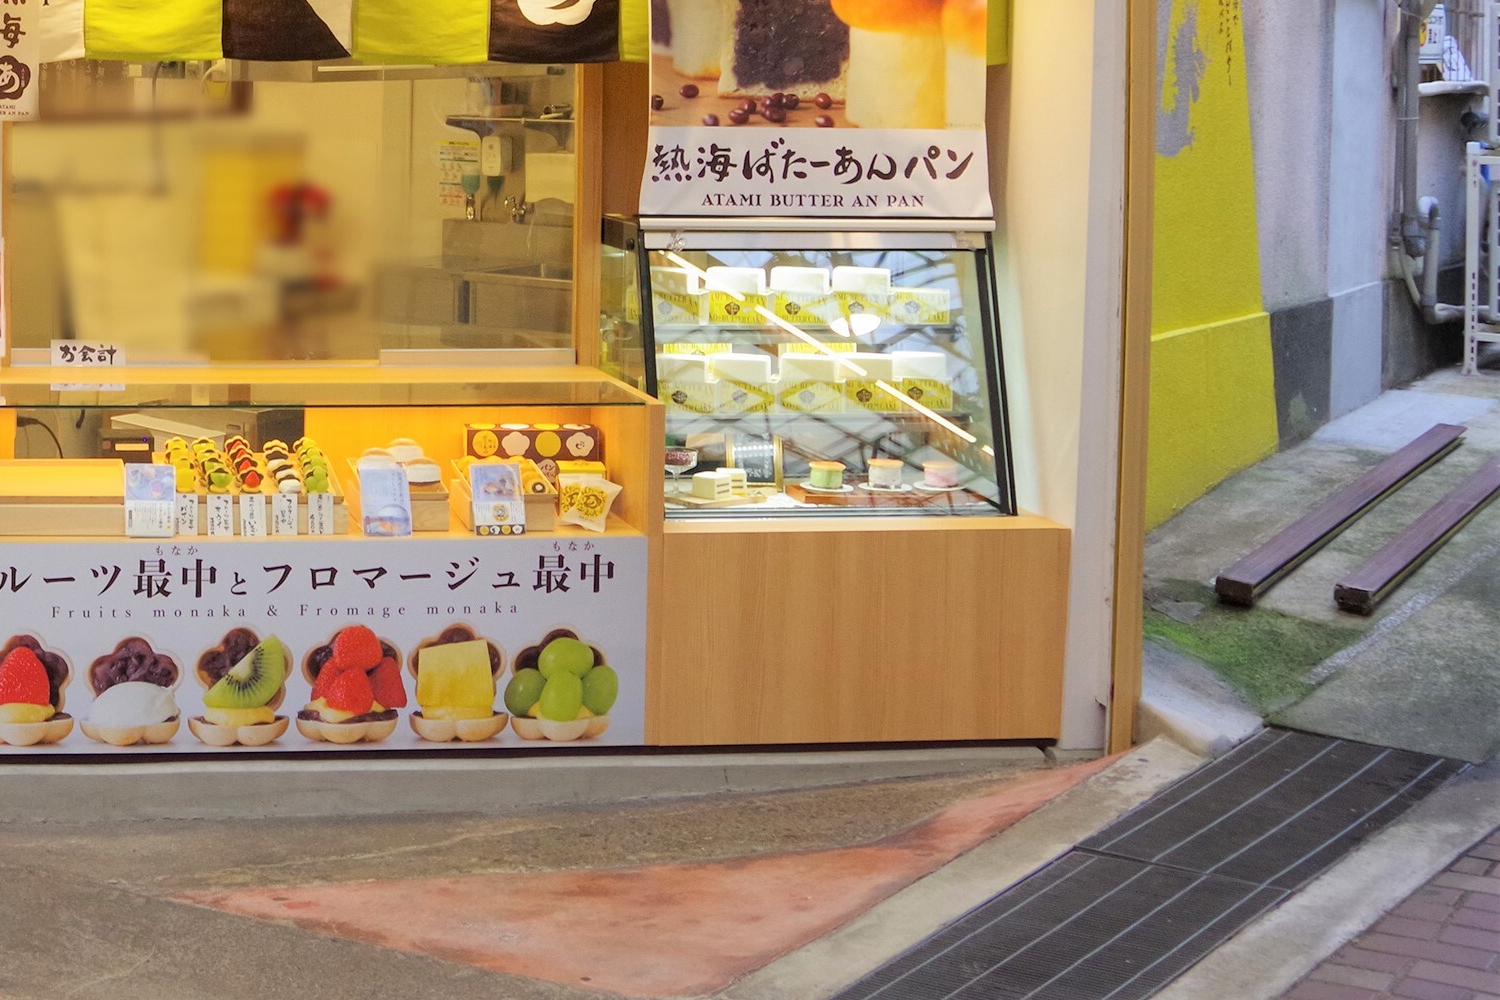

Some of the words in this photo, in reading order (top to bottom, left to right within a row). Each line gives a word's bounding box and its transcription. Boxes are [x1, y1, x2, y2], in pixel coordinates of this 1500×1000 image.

[651, 137, 974, 184] 熱海ばたーあんパン
[701, 192, 762, 208] ATAMI
[770, 193, 844, 208] BUTTER
[852, 194, 879, 208] AN
[886, 194, 925, 208] PAN
[59, 344, 118, 365] お会計
[156, 544, 199, 556] もなか
[552, 540, 595, 552] もなか
[51, 605, 133, 619] Fruits
[153, 604, 246, 619] monaka
[267, 604, 278, 618] &
[300, 603, 406, 619] Fromage
[426, 601, 518, 616] monaka
